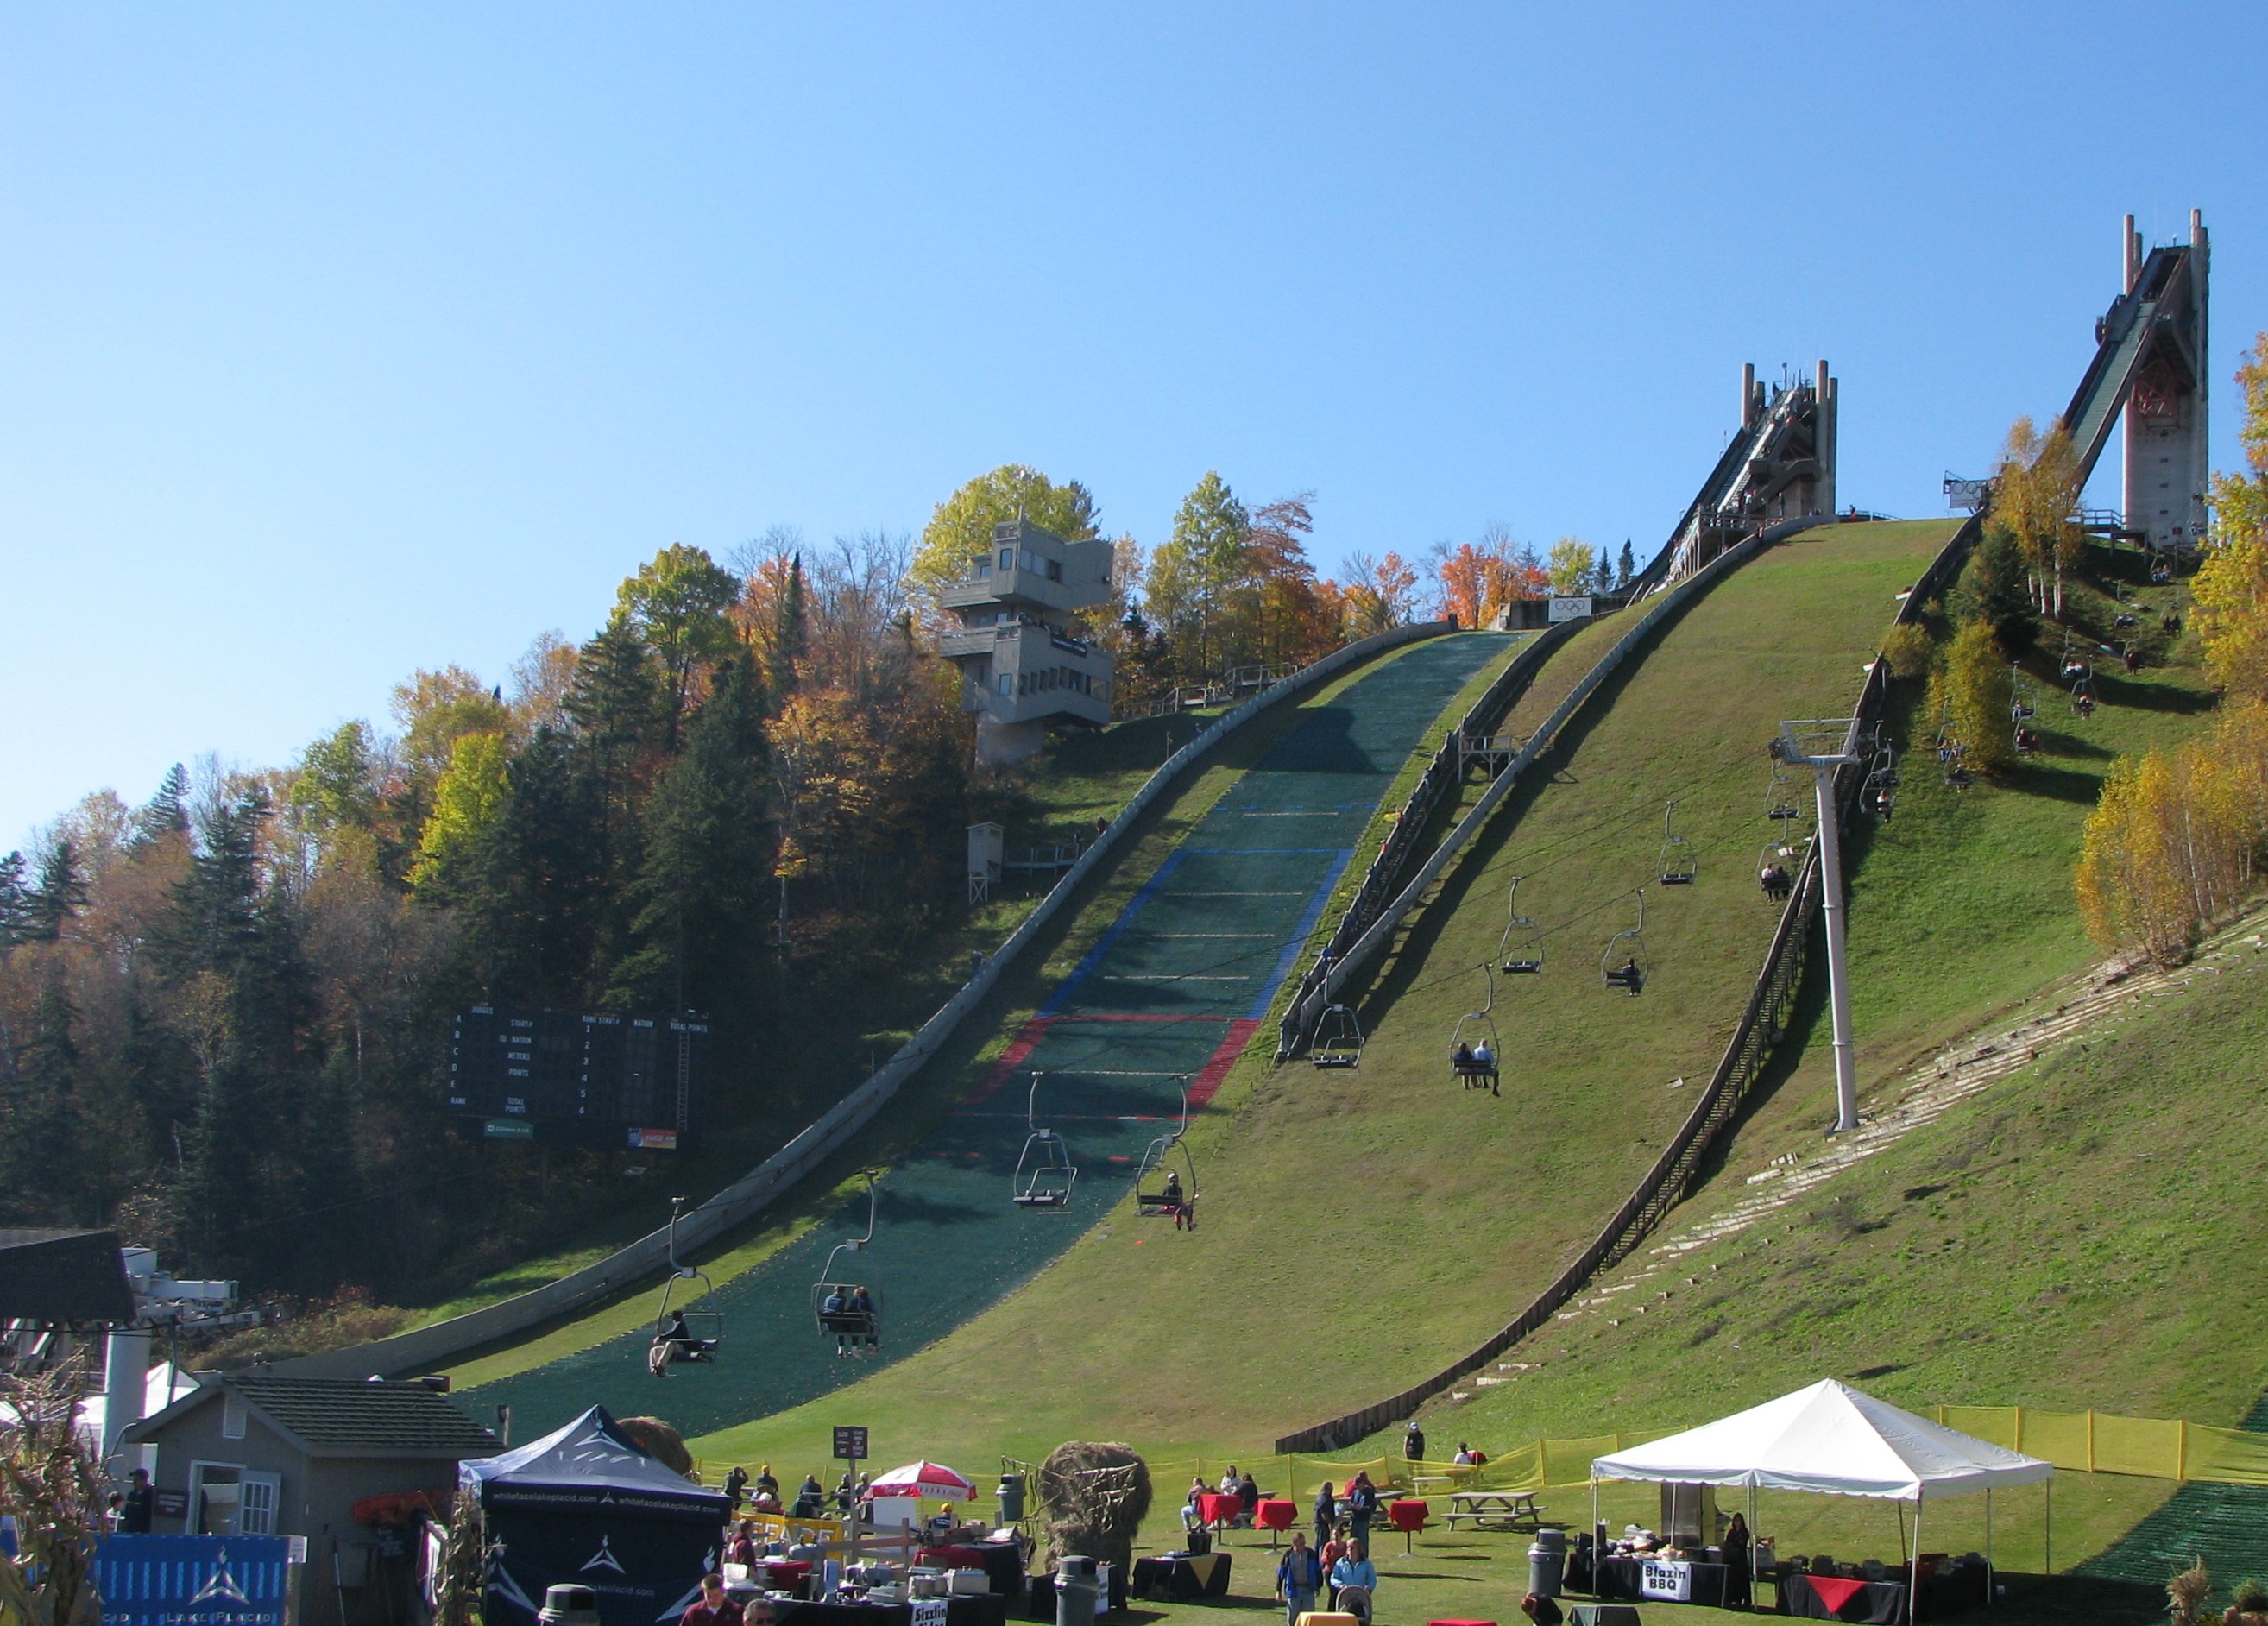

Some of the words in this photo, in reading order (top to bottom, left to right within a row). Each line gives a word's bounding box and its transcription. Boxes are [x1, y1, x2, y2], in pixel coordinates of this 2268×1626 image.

[456, 1014, 462, 1023] A
[633, 1019, 654, 1028] NATION
[670, 1022, 687, 1030] TOTAL
[688, 1024, 709, 1033] POINTS
[585, 1024, 591, 1033] 1
[454, 1030, 461, 1039] B
[511, 1036, 532, 1044] NATION
[583, 1041, 590, 1049] 2
[453, 1047, 459, 1056] C
[507, 1052, 531, 1061] METERS
[451, 1063, 457, 1072] D
[508, 1068, 529, 1077] POINTS
[450, 1080, 457, 1088] E
[580, 1089, 586, 1098] 5
[493, 1491, 597, 1503] whitefacelakeplacid.com
[618, 1497, 721, 1514] whitefacelakeplacid.com
[1646, 1566, 1686, 1579] Blazin
[1649, 1578, 1677, 1591] BBQ
[166, 1611, 208, 1623] LAKE
[217, 1610, 272, 1623] PLACID
